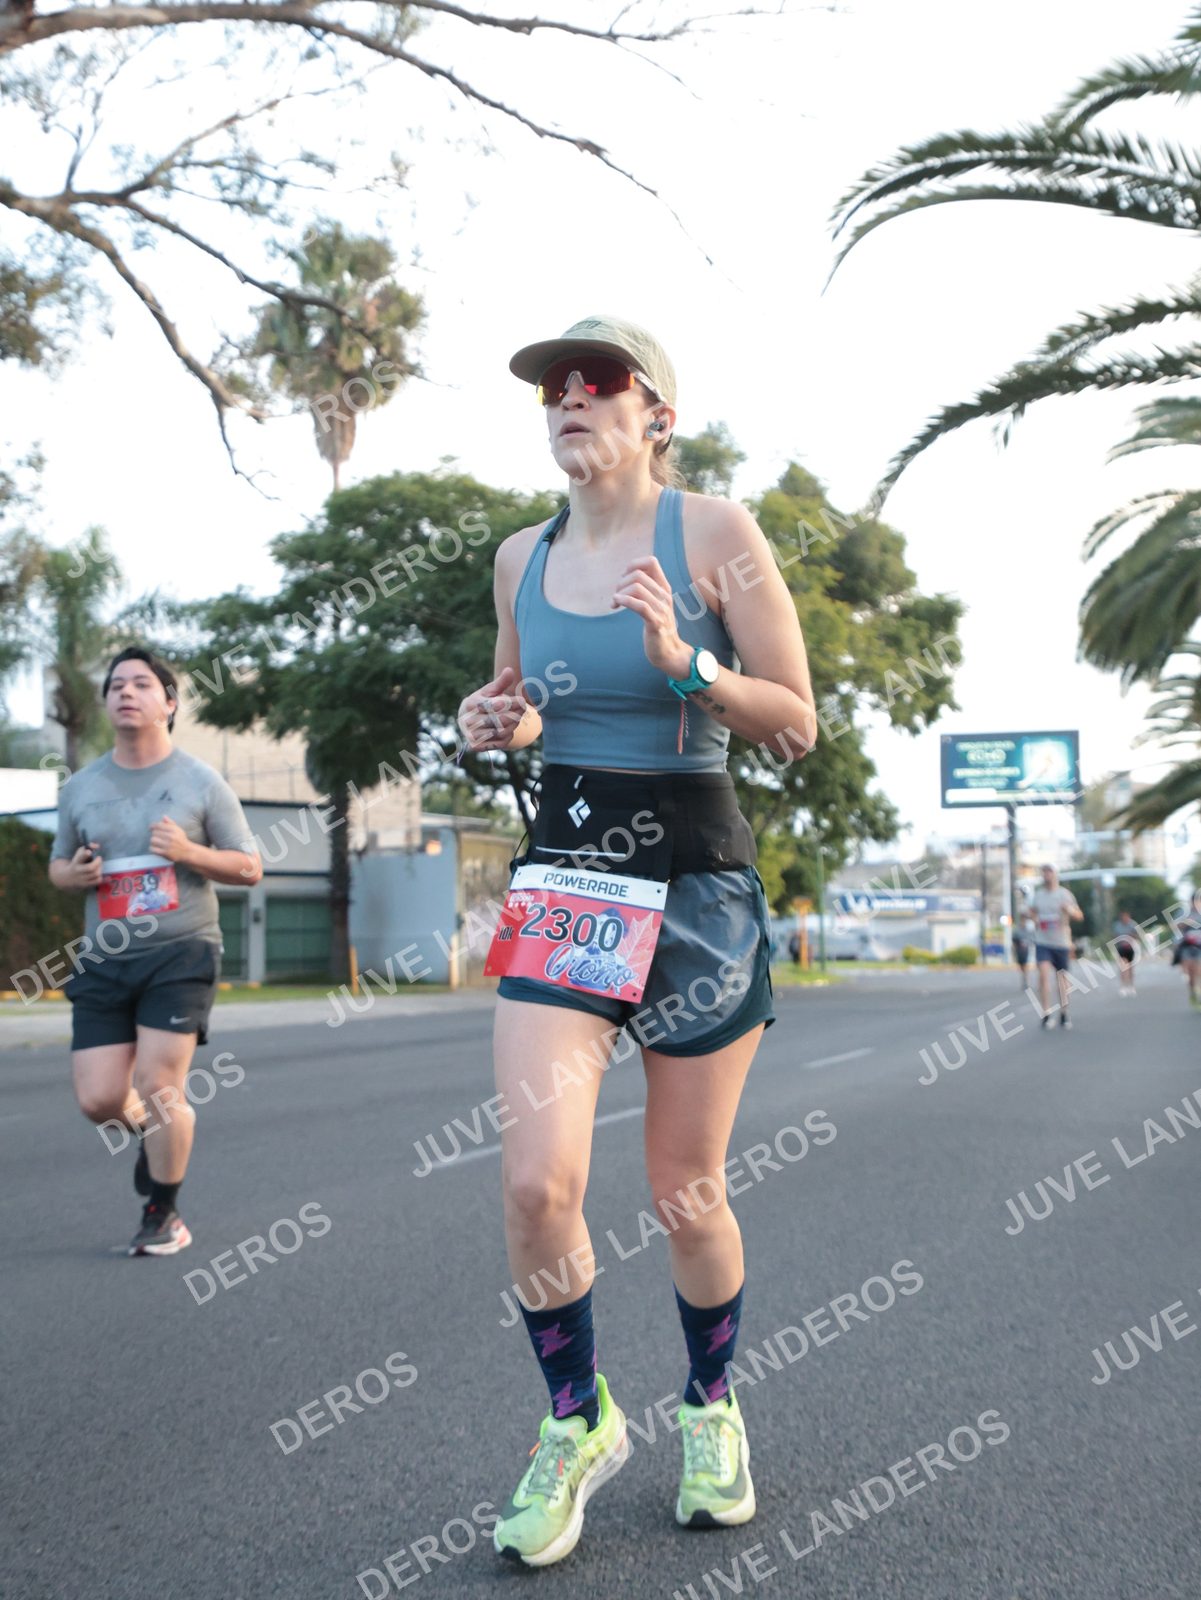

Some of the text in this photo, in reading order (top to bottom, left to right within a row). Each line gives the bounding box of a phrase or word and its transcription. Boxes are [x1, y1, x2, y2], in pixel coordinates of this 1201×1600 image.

[109, 873, 160, 897] 2039
[543, 871, 630, 898] POWERADE
[519, 902, 624, 953] 2300
